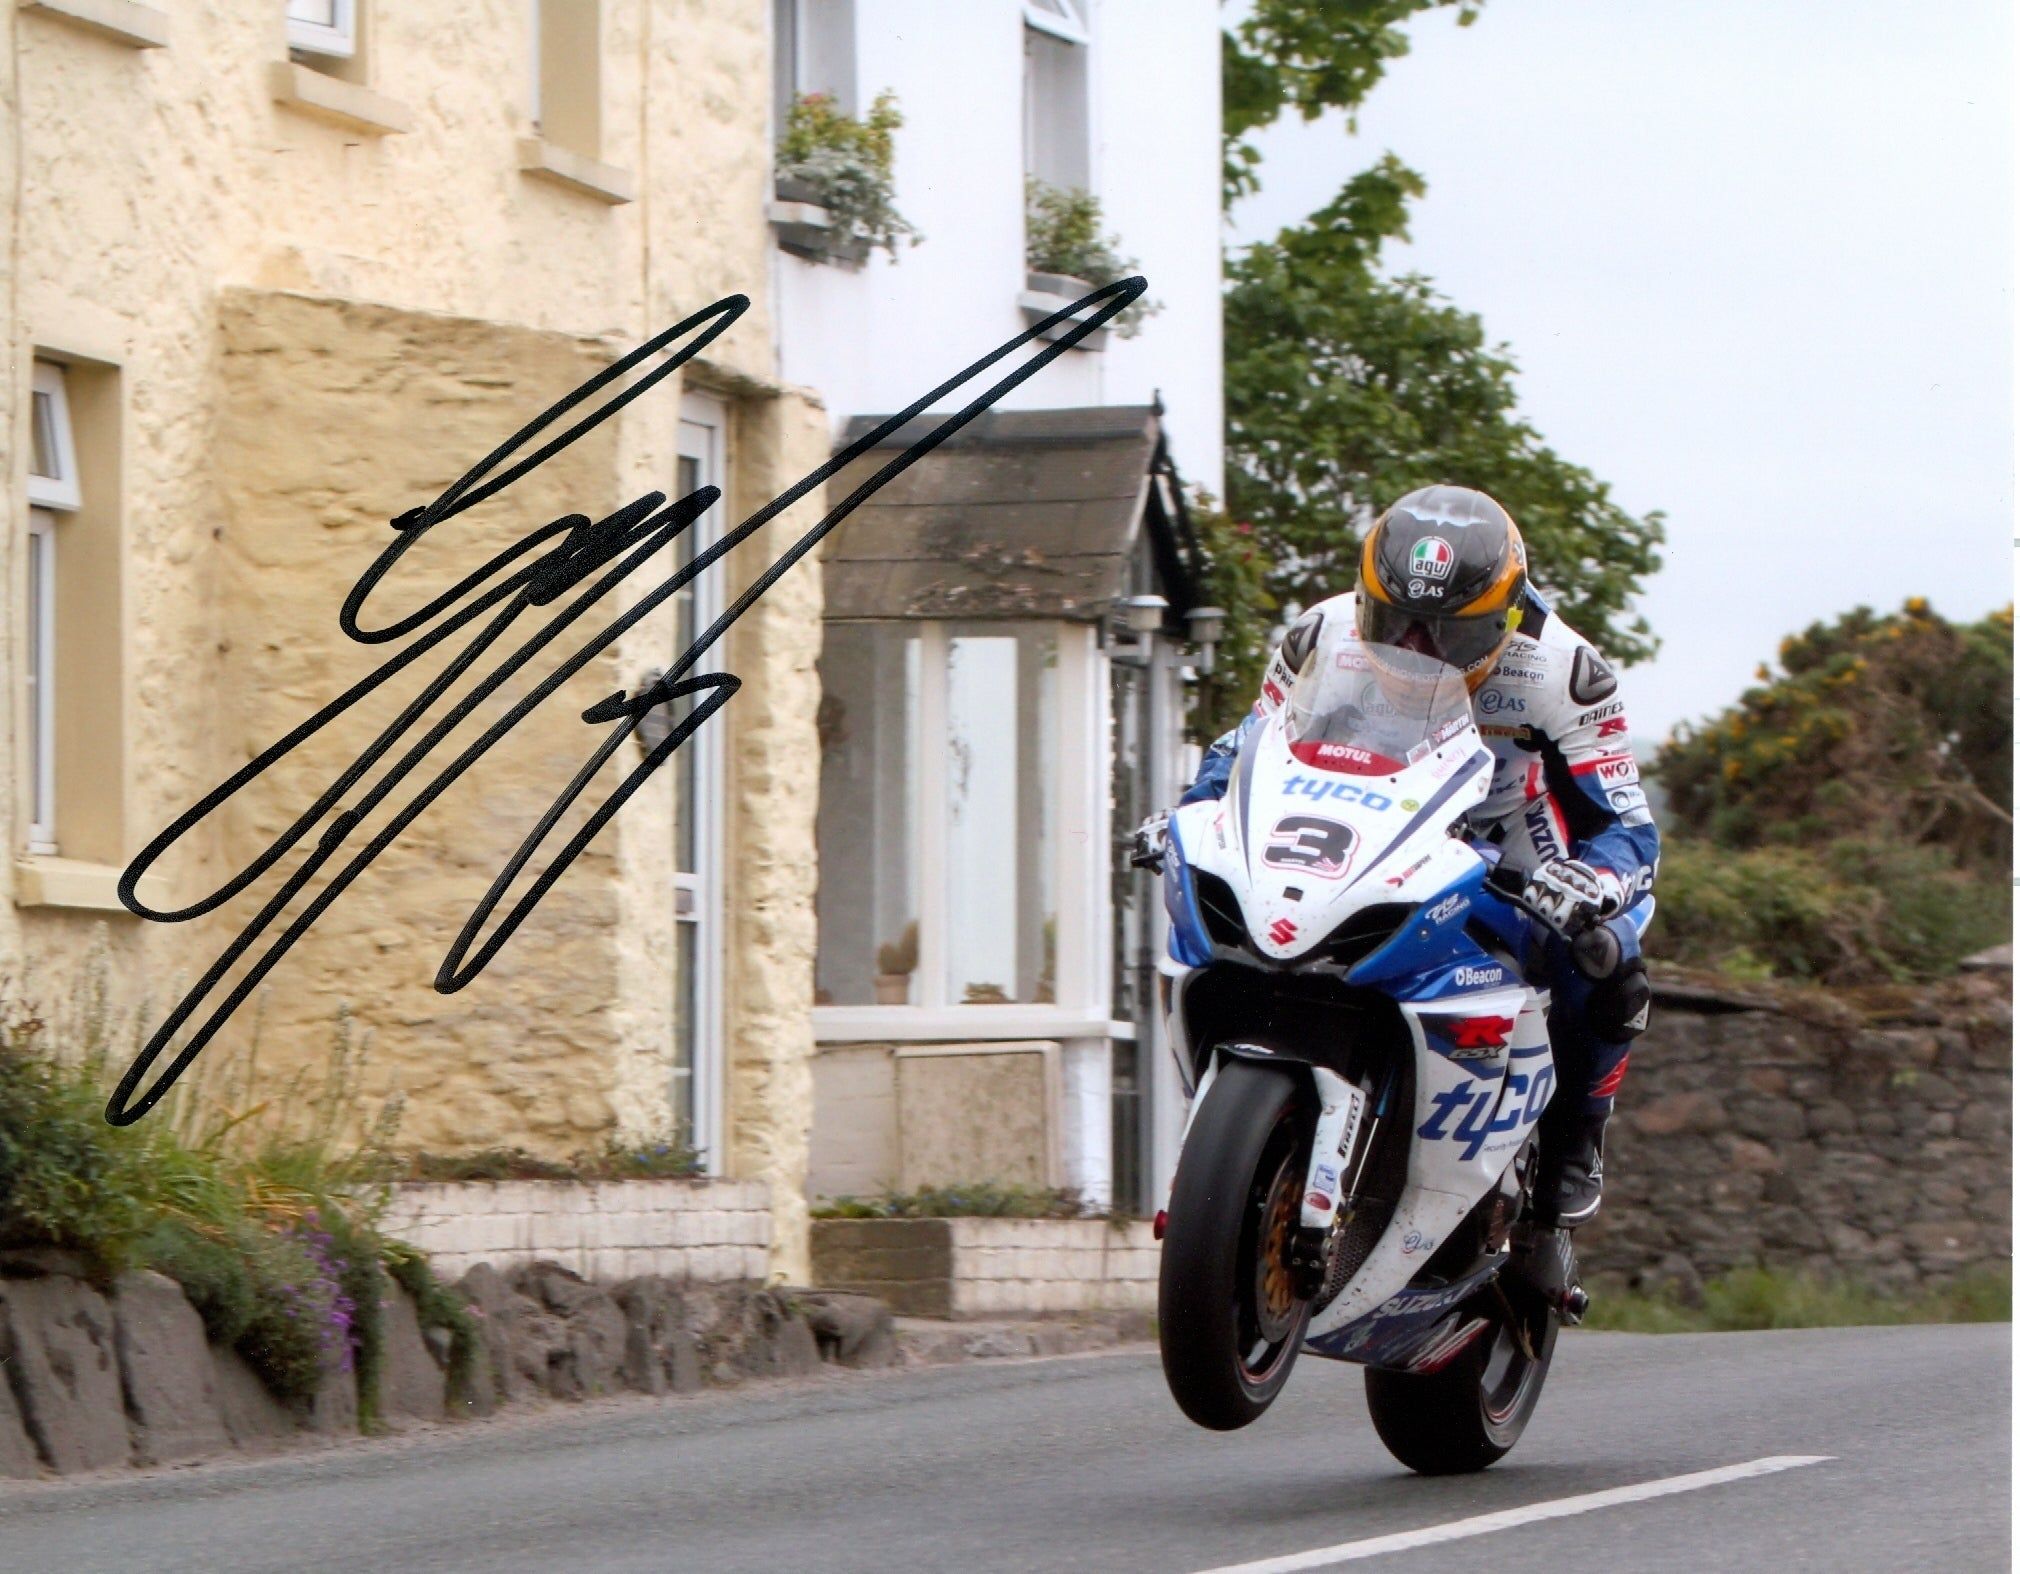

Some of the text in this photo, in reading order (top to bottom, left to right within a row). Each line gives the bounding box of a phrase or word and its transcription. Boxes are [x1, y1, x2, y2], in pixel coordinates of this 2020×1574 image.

[1502, 666, 1545, 681] Beacon
[1317, 744, 1372, 765] MOTUL
[1282, 774, 1393, 812] tyco
[1263, 815, 1355, 871] 3
[1465, 967, 1503, 986] Beacon
[1416, 1063, 1555, 1161] tyco
